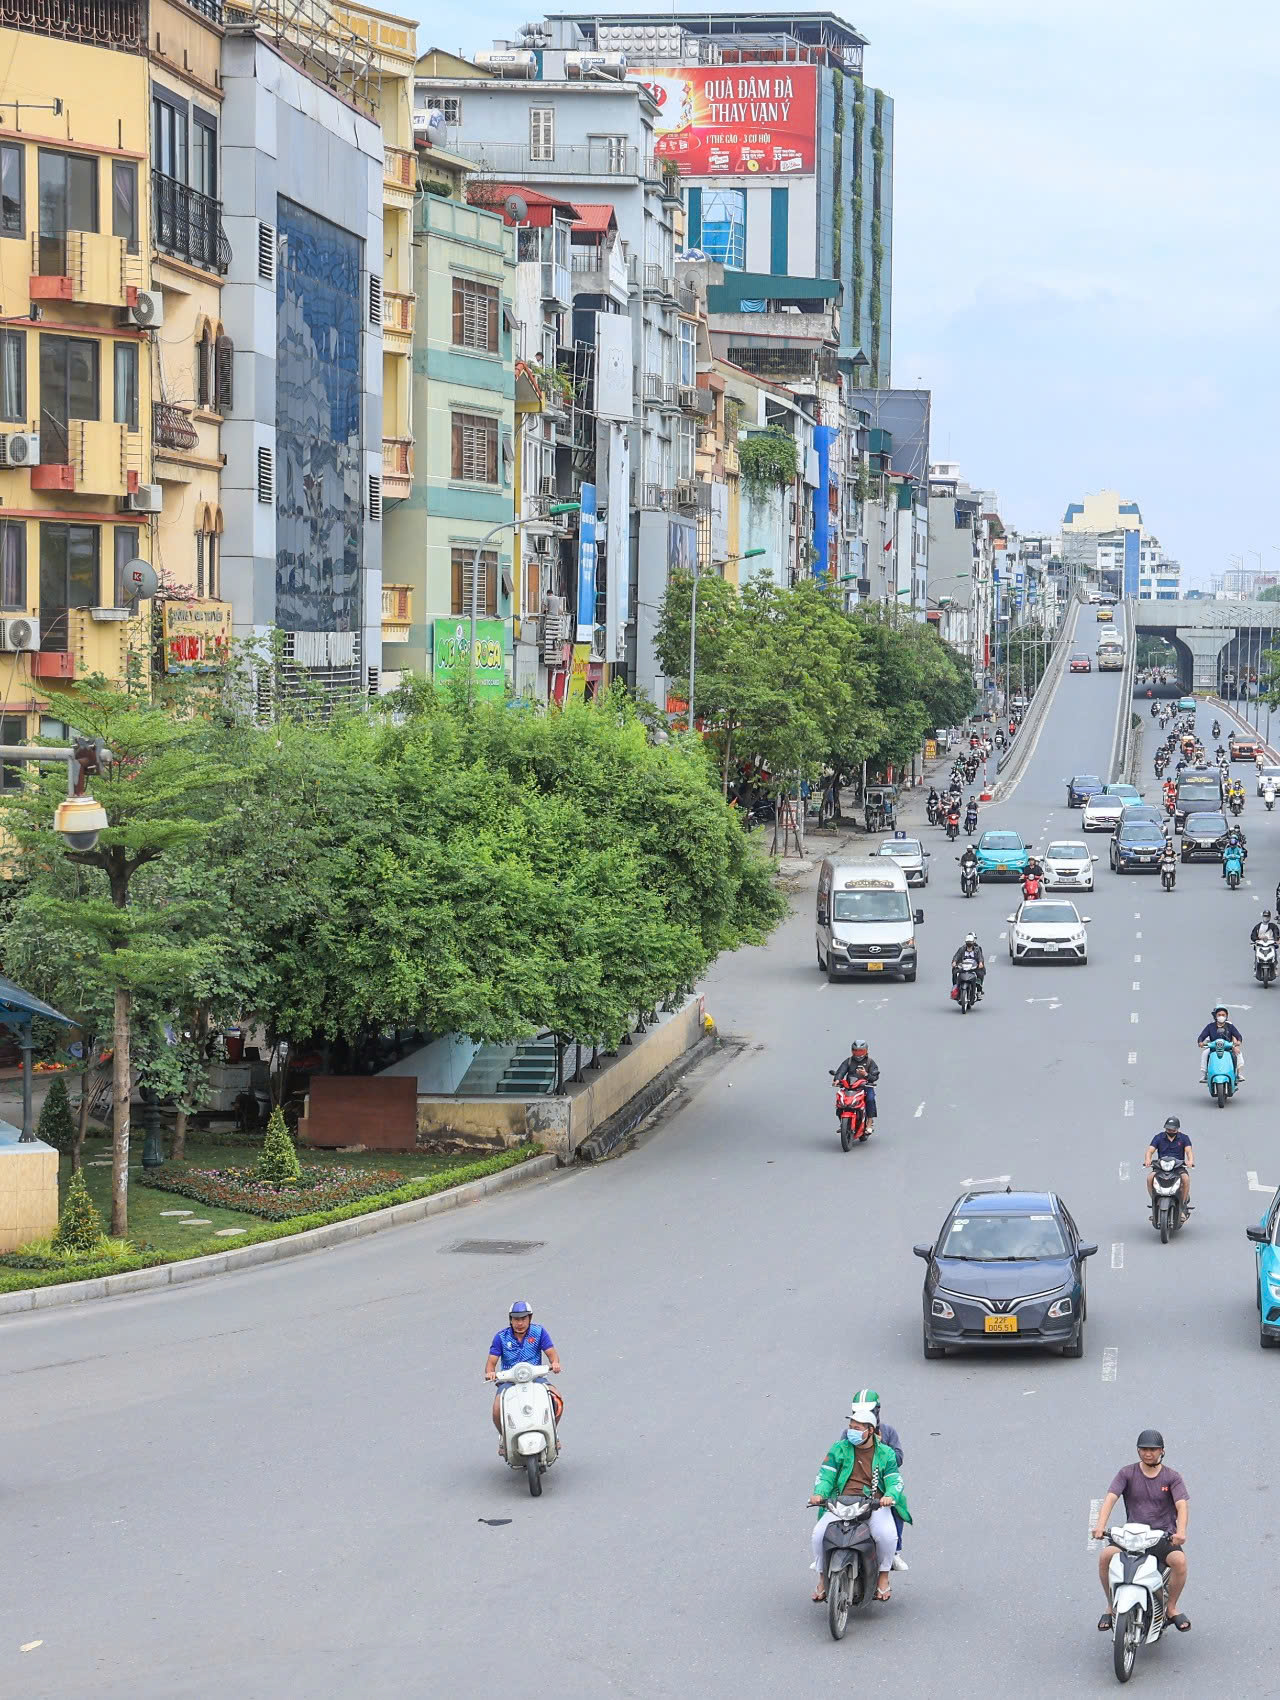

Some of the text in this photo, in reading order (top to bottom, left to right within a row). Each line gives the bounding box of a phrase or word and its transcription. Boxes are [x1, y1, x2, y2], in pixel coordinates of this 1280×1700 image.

[704, 75, 793, 101] QUÀ ĐẬM ĐÀ
[709, 100, 791, 124] THAY VẠN Ý
